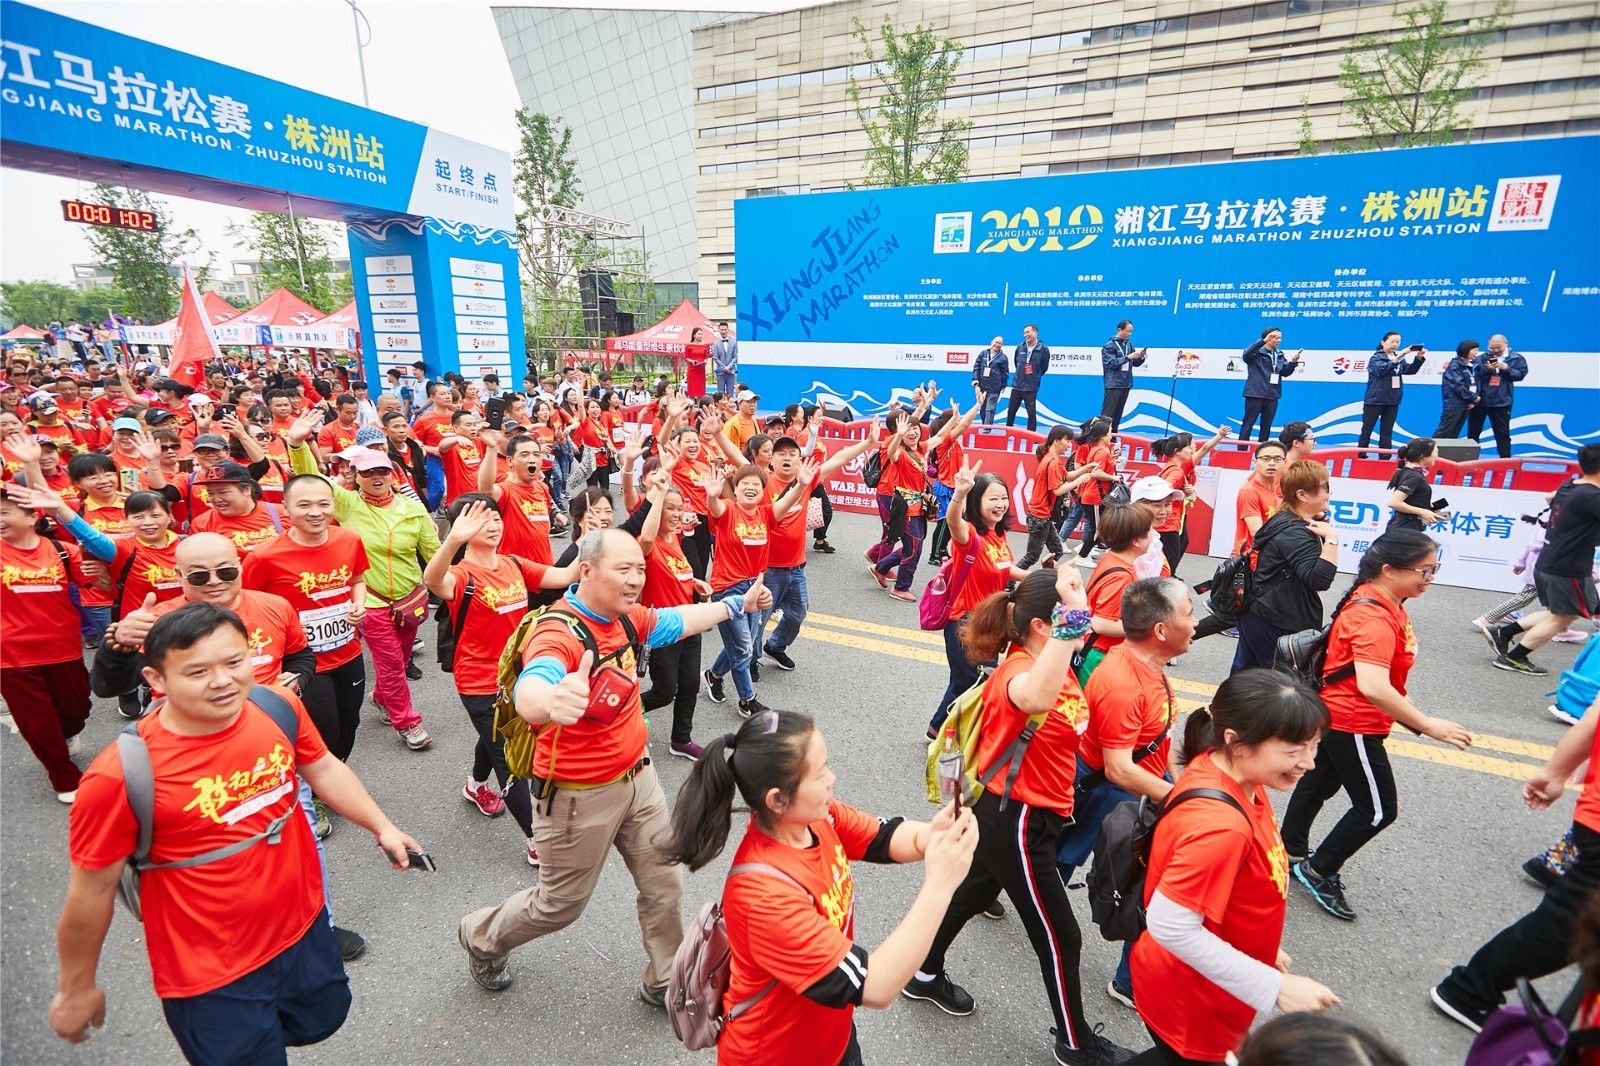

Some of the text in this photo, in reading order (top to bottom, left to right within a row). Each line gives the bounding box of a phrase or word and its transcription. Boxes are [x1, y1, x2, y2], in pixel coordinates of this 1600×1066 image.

[114, 113, 232, 152] MARATHON
[245, 143, 324, 171] ZHUZHOU
[327, 162, 387, 185] STATION
[975, 204, 1104, 254] 2019
[987, 225, 1104, 240] XIANGJIANG MARATHON
[1112, 222, 1481, 248] XIANGJIANG MARATHON ZHUZHOU STATION
[798, 234, 900, 339] MARATHON
[830, 480, 855, 493] WAR
